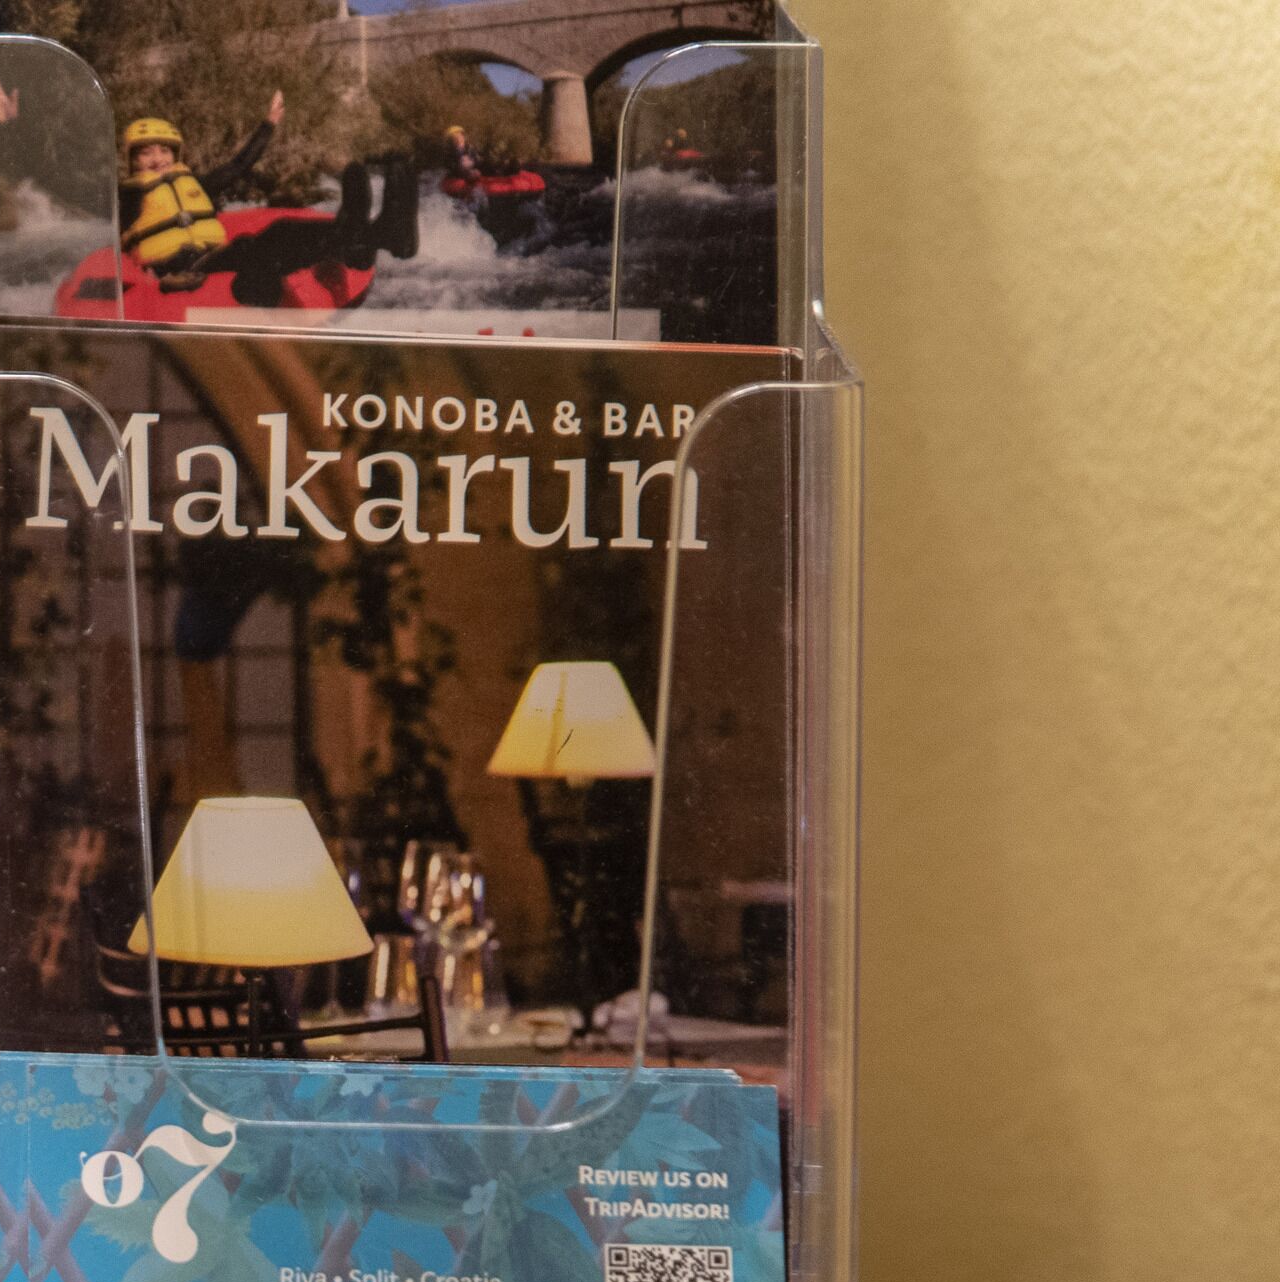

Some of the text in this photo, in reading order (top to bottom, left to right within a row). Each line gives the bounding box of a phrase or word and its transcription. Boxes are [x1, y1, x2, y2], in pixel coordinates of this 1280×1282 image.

[321, 392, 698, 439] KONOBA & BAR
[24, 406, 709, 551] Makarun
